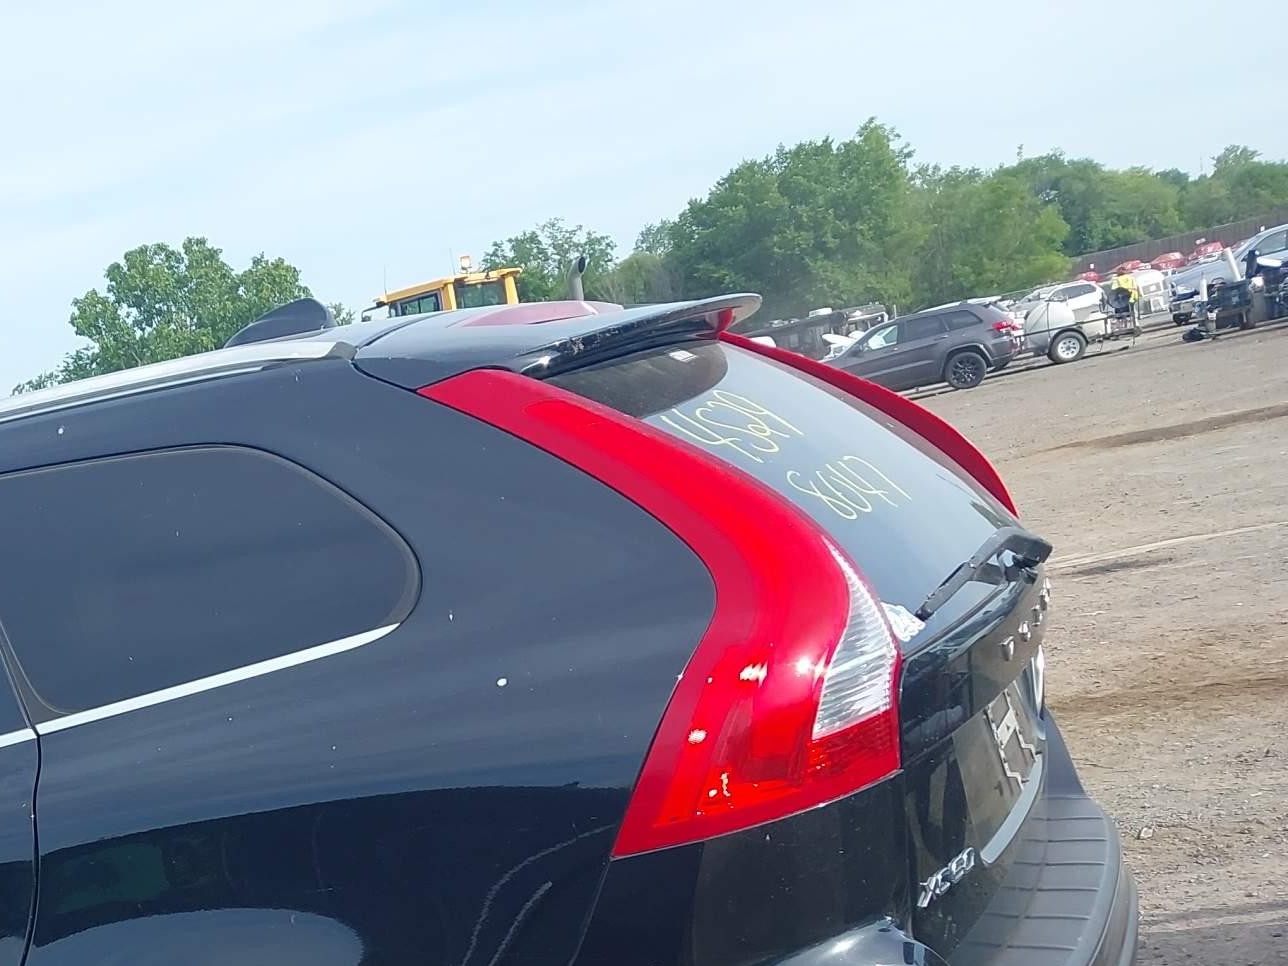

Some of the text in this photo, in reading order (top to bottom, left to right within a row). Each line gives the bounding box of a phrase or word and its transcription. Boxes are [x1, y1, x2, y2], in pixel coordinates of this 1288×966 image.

[661, 389, 804, 463] 4529
[786, 455, 913, 520] 8047
[917, 847, 975, 907] XC60
